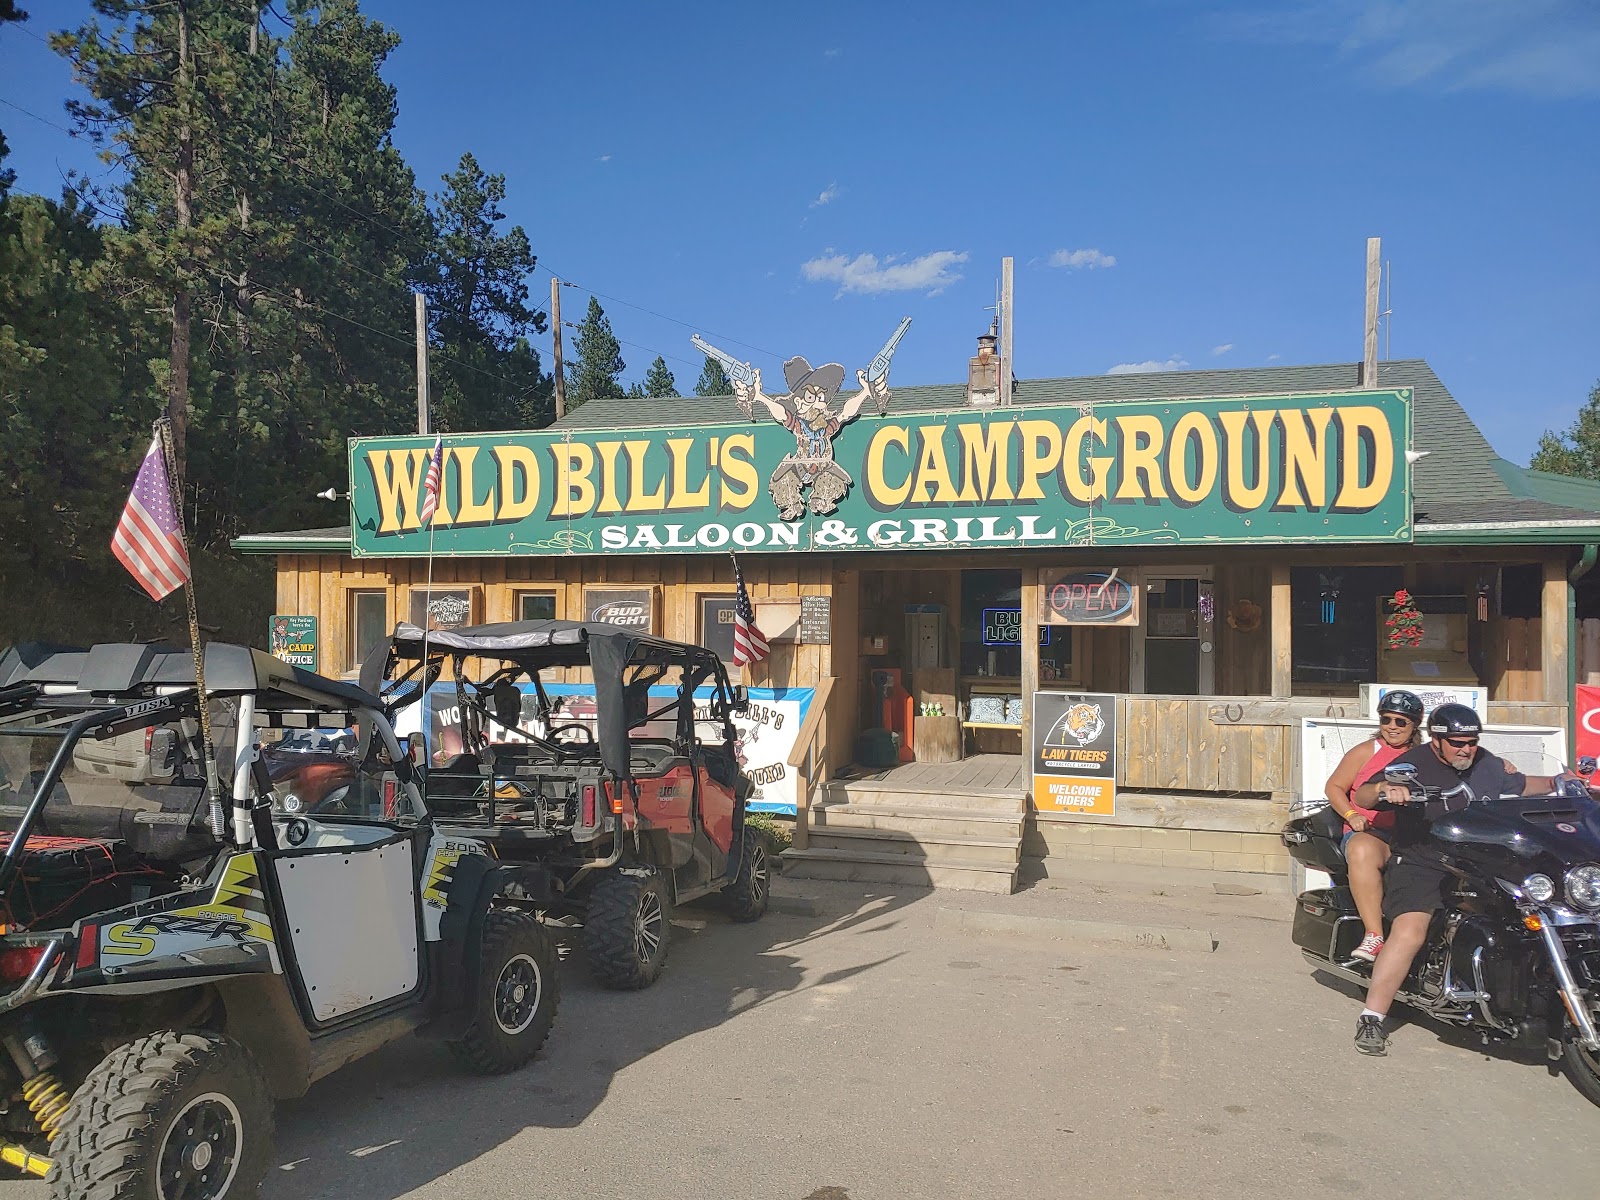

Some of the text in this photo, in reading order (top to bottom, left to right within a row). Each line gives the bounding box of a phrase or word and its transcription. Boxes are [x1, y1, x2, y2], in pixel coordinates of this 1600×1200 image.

[363, 405, 1394, 537] WILD BILL'S CAMPGROUND
[601, 514, 1056, 550] SALOON & GRILL
[1051, 583, 1120, 611] OPEN
[607, 607, 643, 616] BUD
[994, 611, 1022, 626] BU
[986, 626, 1047, 642] LIGT
[289, 643, 315, 652] CAMP
[277, 651, 314, 665] OFFICE
[128, 697, 169, 716] TUSK
[1041, 748, 1108, 762] LAW TIGERS
[1049, 783, 1103, 797] WELCOME
[1055, 794, 1096, 807] RIDERS
[197, 910, 238, 922] POLARIS
